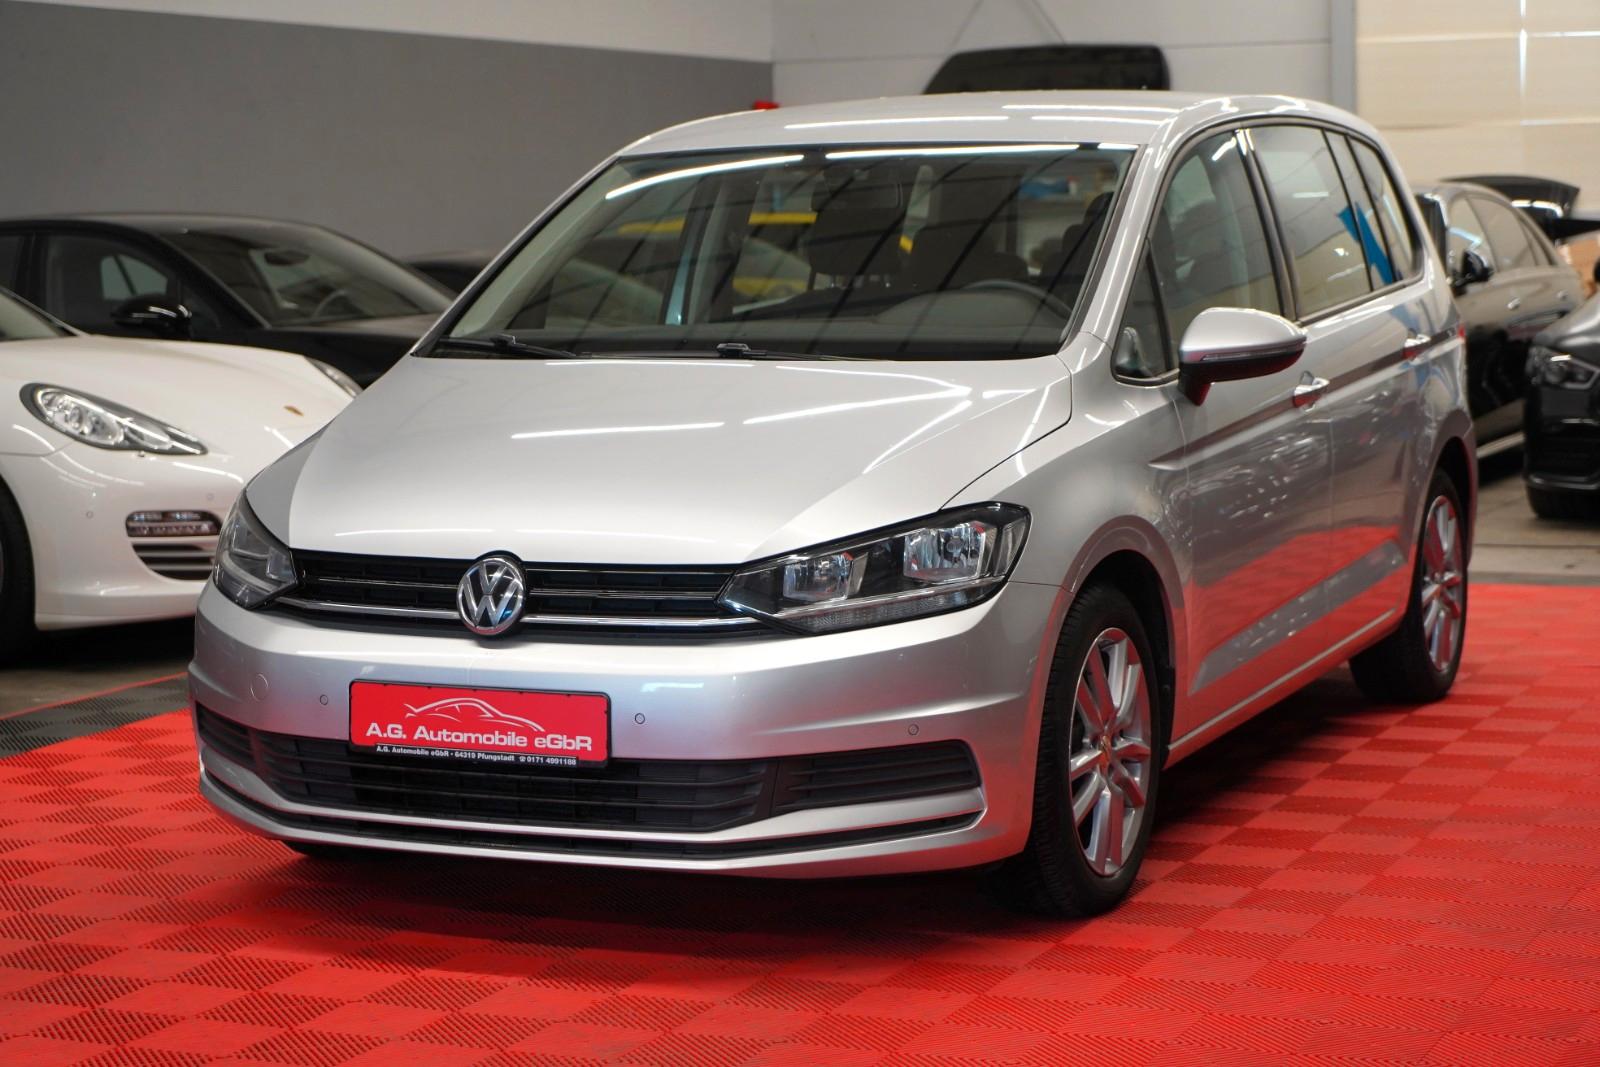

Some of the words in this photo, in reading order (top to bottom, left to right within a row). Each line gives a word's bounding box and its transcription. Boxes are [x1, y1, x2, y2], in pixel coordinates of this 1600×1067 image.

[461, 559, 522, 631] VW
[366, 722, 407, 739] A.G.
[413, 725, 528, 746] Automobile
[534, 733, 592, 751] eGbR
[376, 745, 391, 753] A.G.
[392, 747, 430, 756] Automobile
[477, 753, 515, 762] Pfungstadt
